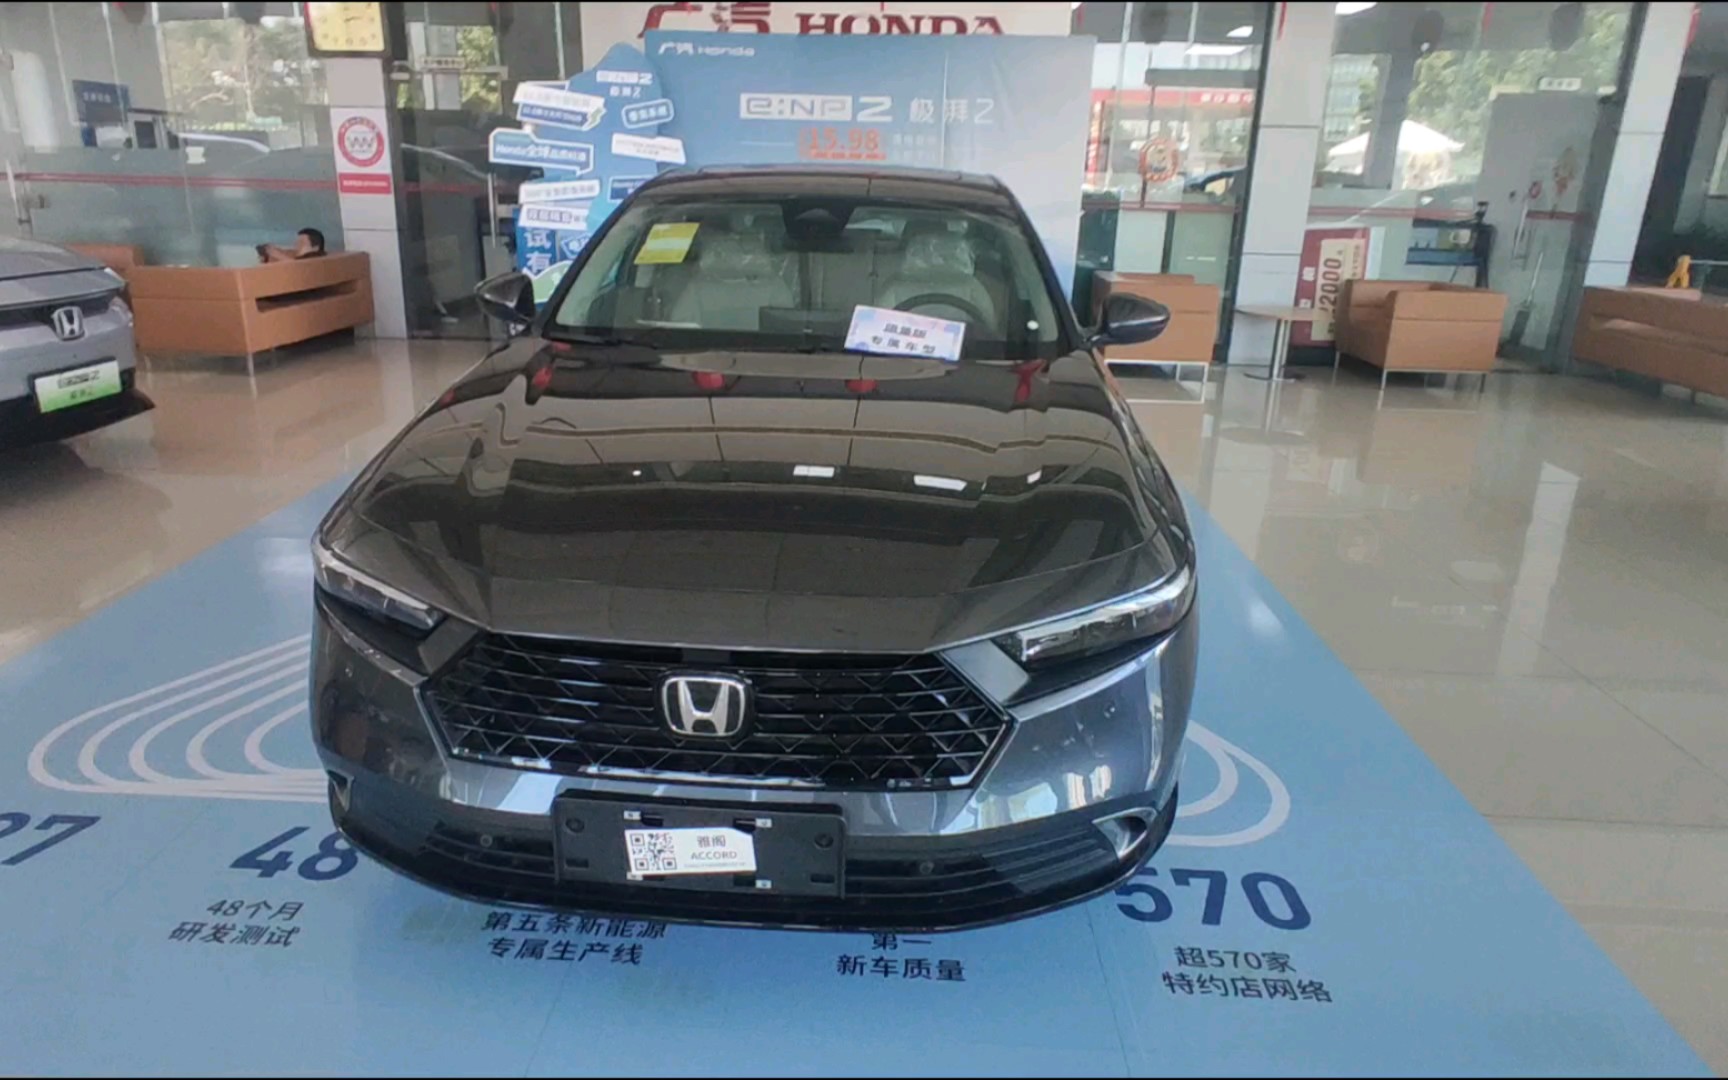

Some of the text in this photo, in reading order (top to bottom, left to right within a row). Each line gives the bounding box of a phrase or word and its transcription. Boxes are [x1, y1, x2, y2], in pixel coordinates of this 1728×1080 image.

[795, 13, 1004, 36] HONDA
[229, 826, 359, 881] 48
[690, 851, 738, 860] ACCORD
[206, 900, 304, 922] 48个月
[1114, 867, 1312, 930] 570
[168, 922, 301, 947] 研发测试
[481, 911, 667, 939] 第五条新能源
[487, 937, 644, 965] 专属生产线
[871, 932, 932, 951] 第一
[836, 953, 966, 982] 新车质量
[1173, 946, 1297, 973] 超570家
[1162, 971, 1333, 1003] 特约店网络
